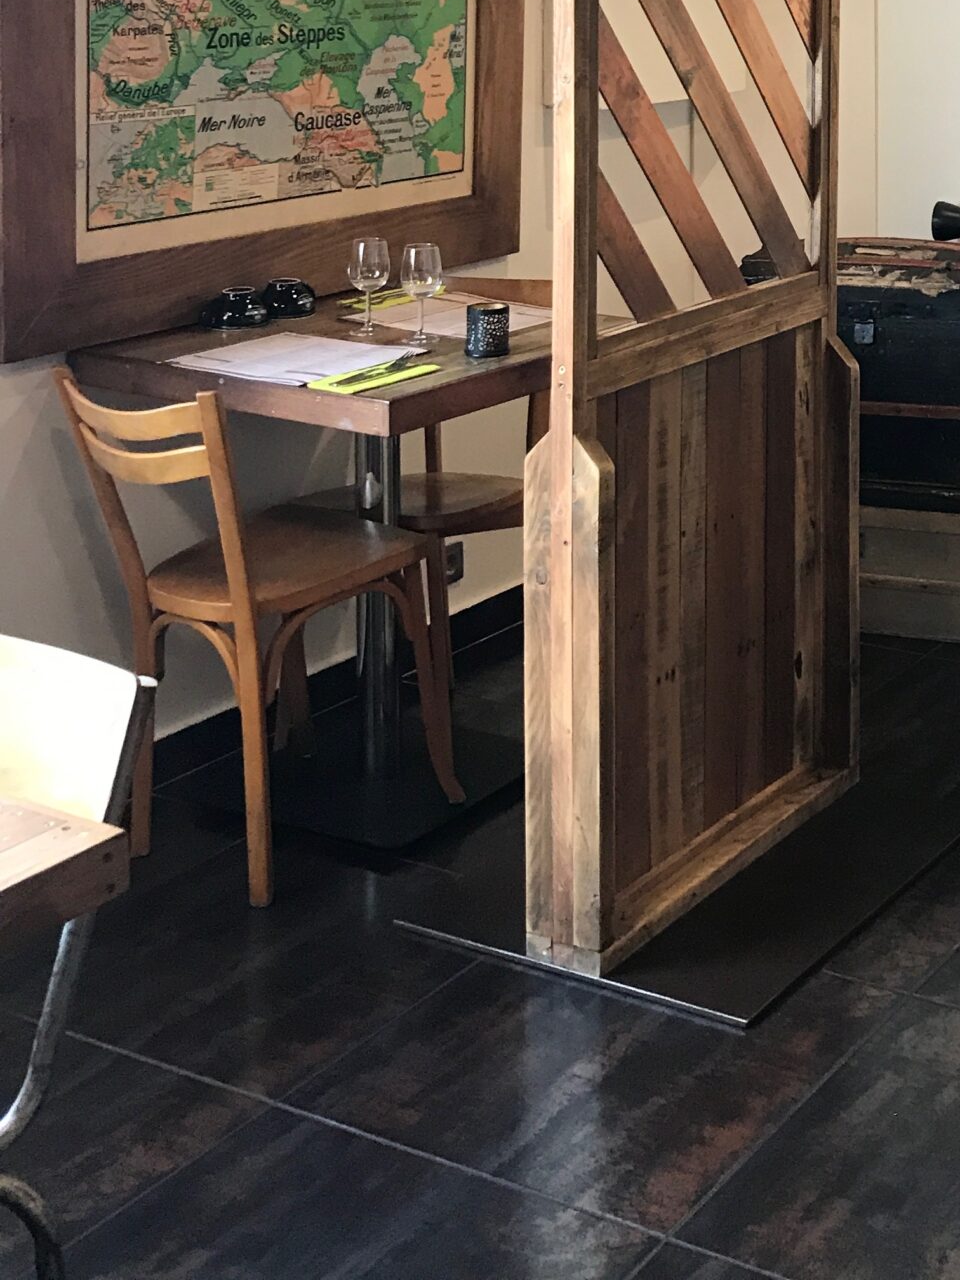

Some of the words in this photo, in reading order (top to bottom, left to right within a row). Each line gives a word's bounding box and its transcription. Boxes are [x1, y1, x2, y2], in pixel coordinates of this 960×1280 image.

[113, 24, 163, 39] Karpates
[206, 27, 251, 50] Zone
[255, 32, 274, 46] des
[277, 23, 345, 50] Steppes
[112, 80, 171, 100] Danube
[375, 87, 394, 99] Mer
[198, 118, 228, 133] Mer
[228, 114, 266, 130] Noire
